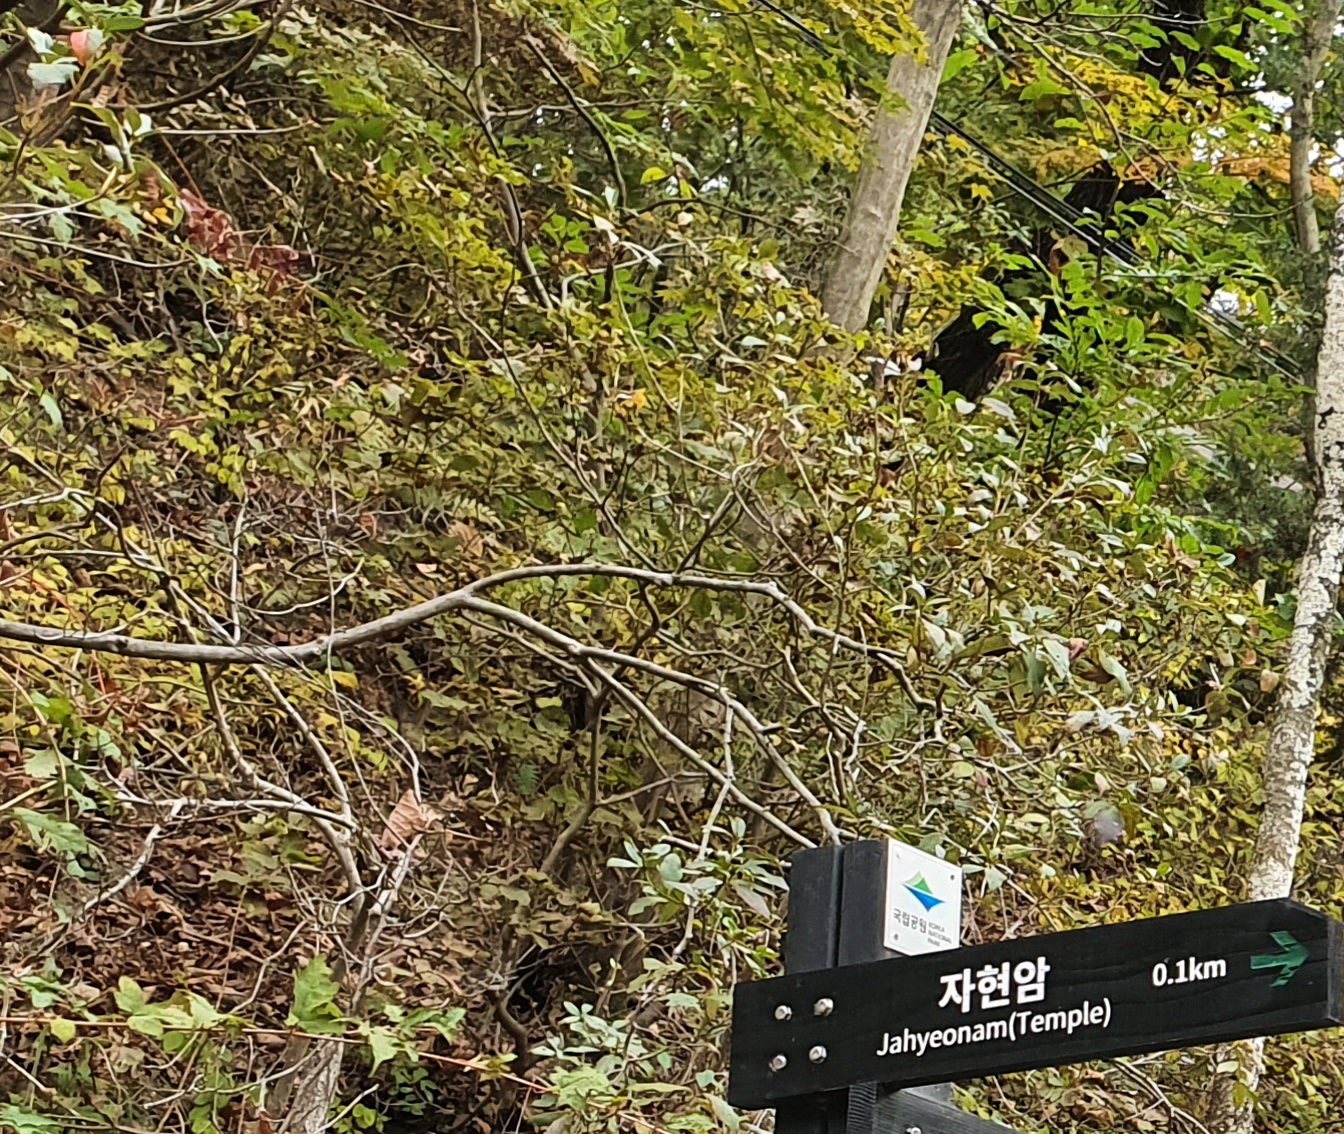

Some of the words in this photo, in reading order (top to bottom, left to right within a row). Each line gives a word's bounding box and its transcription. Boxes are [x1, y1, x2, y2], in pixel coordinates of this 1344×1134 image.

[893, 907, 927, 934] 국립공원
[928, 921, 945, 933] KOREA
[928, 930, 952, 944] NATIONAL
[938, 956, 1051, 1014] 자현암
[1152, 957, 1227, 987] 0.1km
[876, 998, 1112, 1057] Jahyeonam(Temple)
